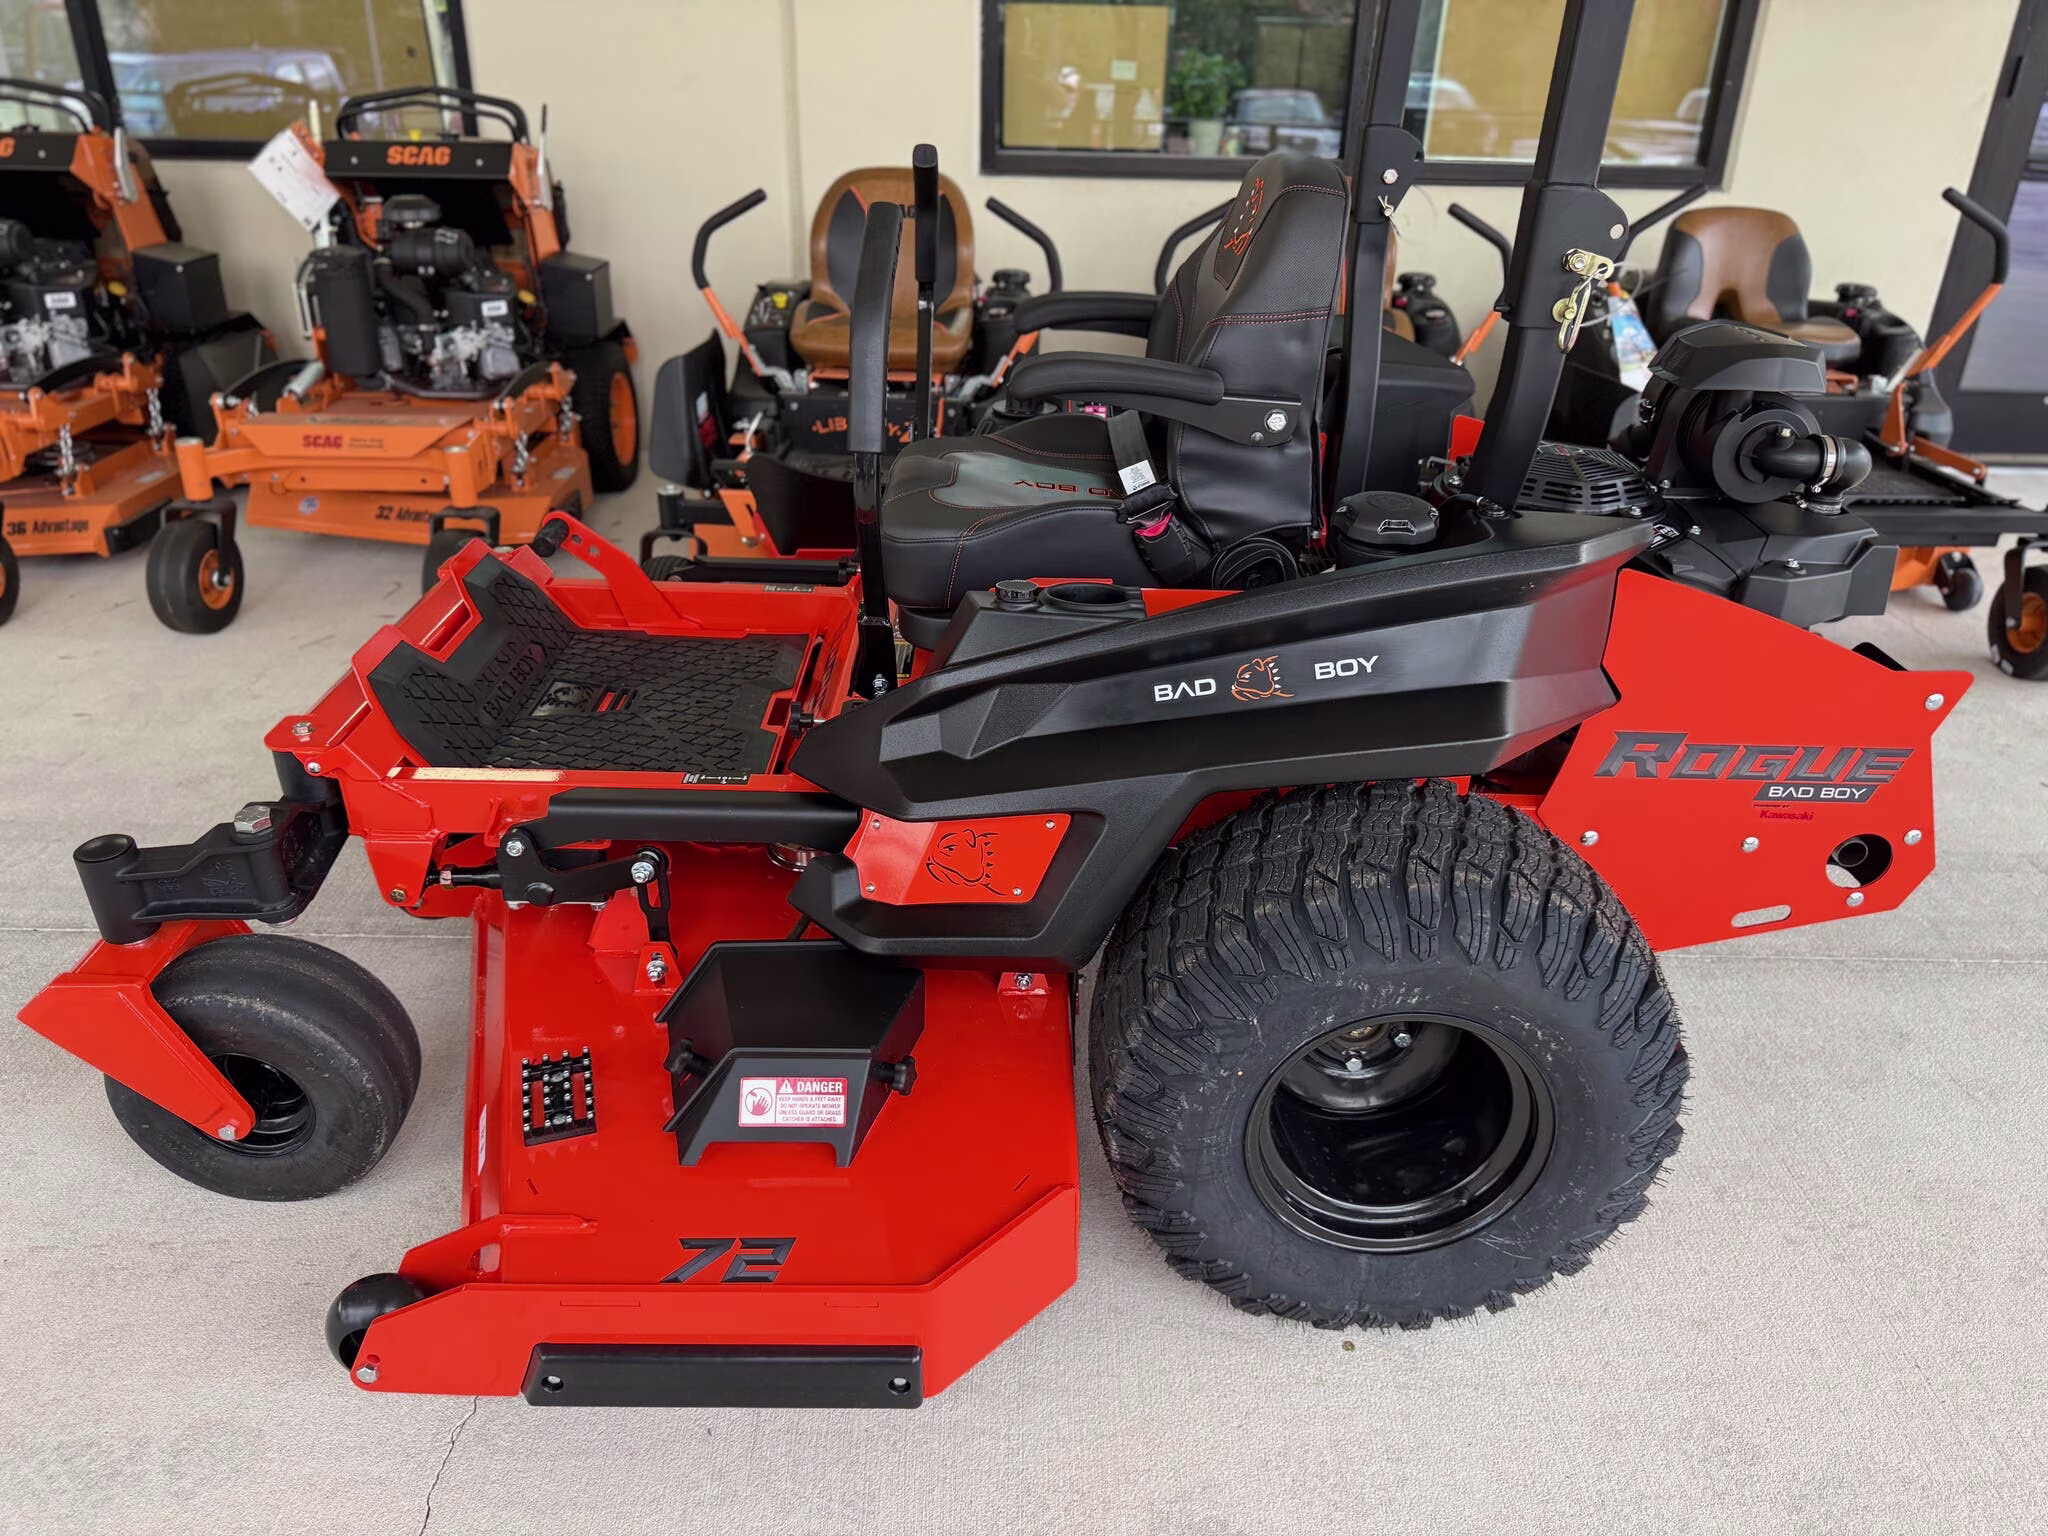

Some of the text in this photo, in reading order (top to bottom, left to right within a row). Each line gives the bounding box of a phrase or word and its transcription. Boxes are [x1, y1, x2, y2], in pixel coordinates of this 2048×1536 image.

[387, 146, 451, 165] SCAG
[303, 435, 342, 448] SCAG
[375, 505, 394, 520] 32
[7, 520, 89, 535] 36 Advantage
[1154, 655, 1379, 702] BAD BOY
[1768, 786, 1868, 799] BAD BOY
[1760, 810, 1815, 820] Kawasaki
[797, 1081, 842, 1093] DANGER
[659, 1237, 797, 1283] 72
